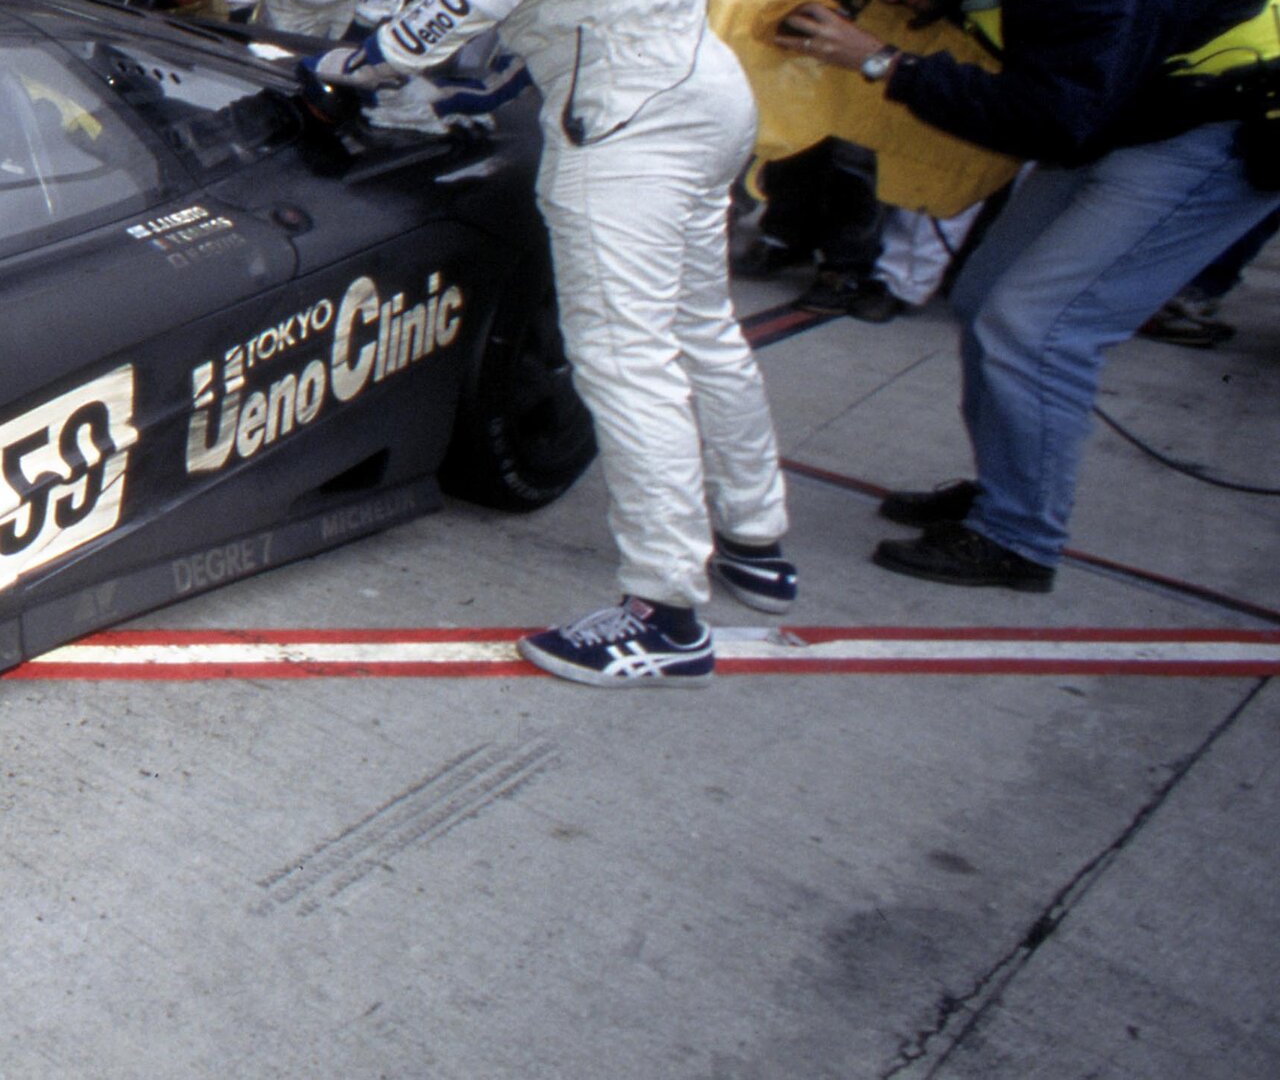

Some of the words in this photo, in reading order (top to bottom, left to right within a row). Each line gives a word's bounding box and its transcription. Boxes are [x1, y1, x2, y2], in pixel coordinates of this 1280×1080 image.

[391, 12, 455, 56] Ueno
[247, 298, 334, 368] TOKYO
[185, 344, 327, 473] Ueno
[330, 271, 463, 402] Clinic
[171, 541, 256, 593] DEGRE
[259, 532, 275, 565] 7
